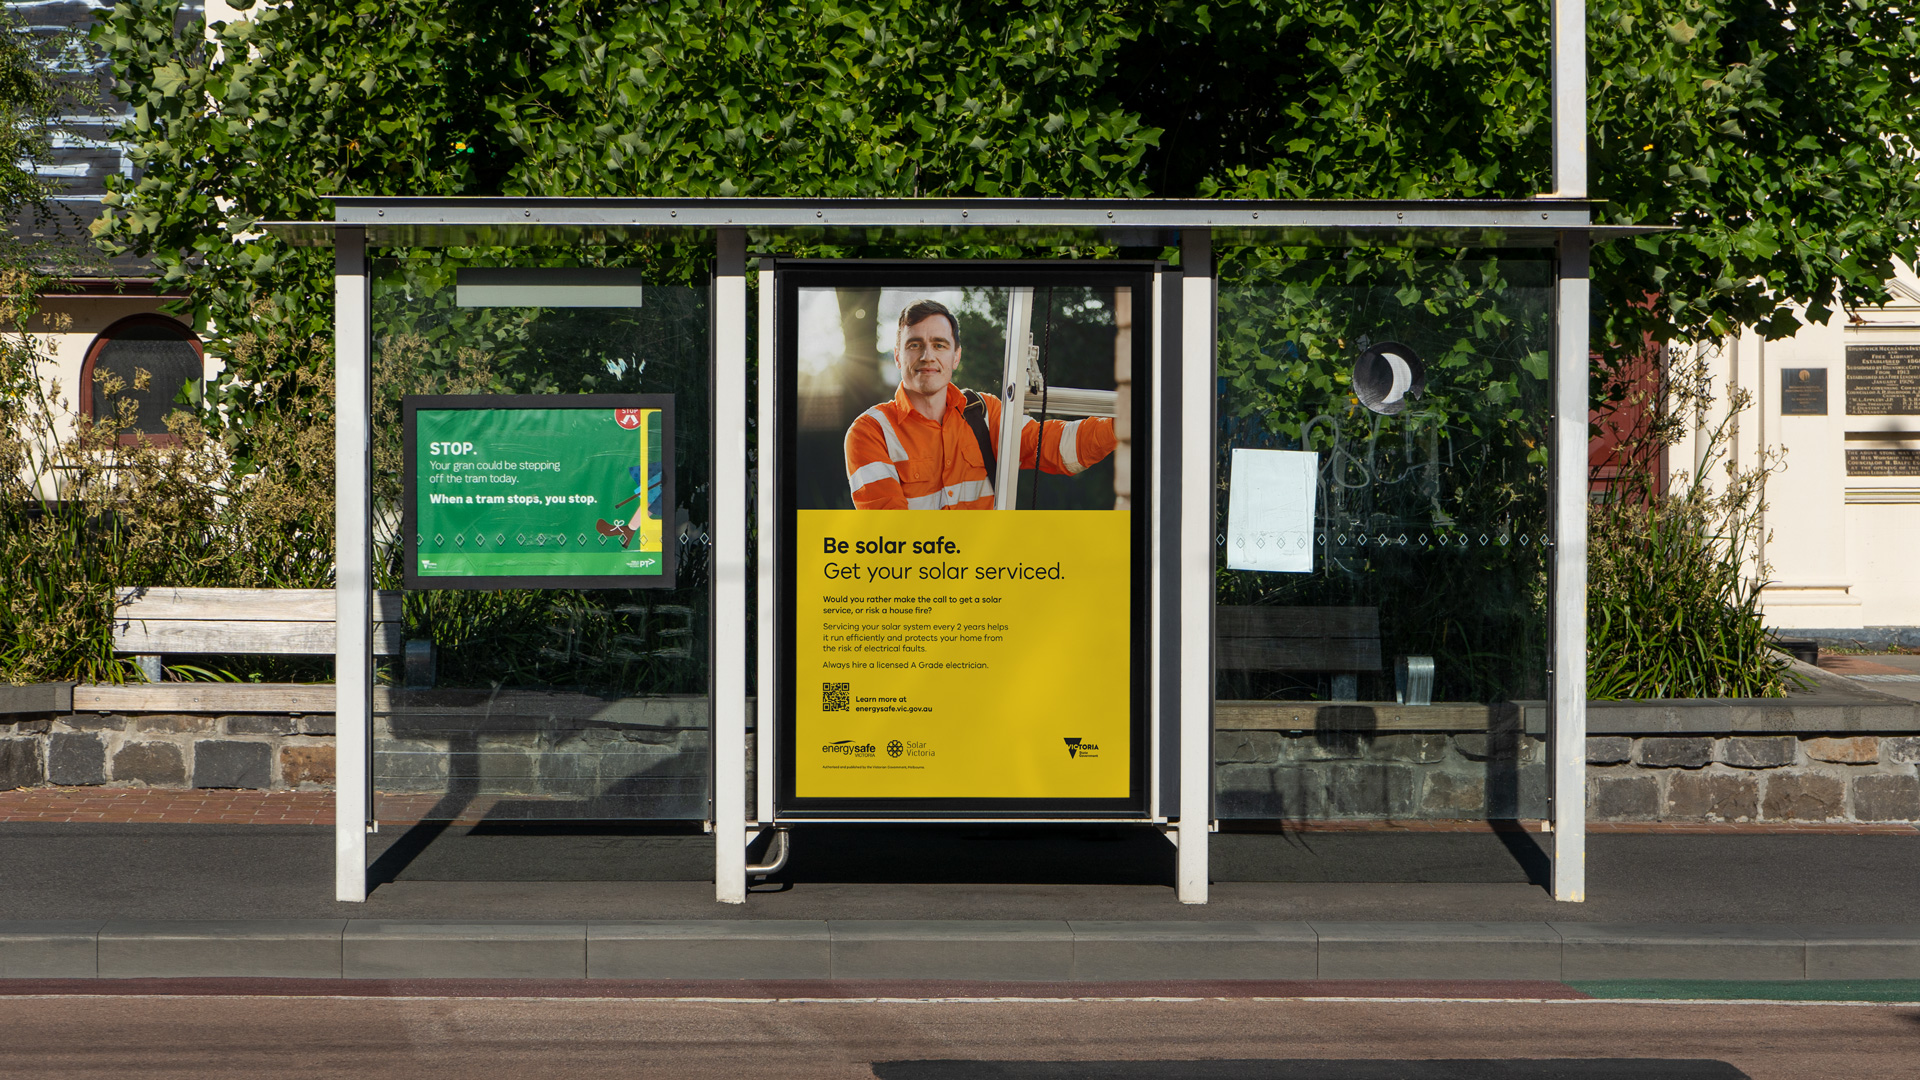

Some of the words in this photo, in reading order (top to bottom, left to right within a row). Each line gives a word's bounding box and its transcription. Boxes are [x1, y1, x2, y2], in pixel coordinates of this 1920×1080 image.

[430, 442, 478, 455] STOP.
[430, 461, 451, 470] Your
[453, 462, 474, 472] gran
[476, 461, 502, 470] could
[504, 460, 517, 470] be
[519, 460, 560, 472] stepping
[429, 473, 444, 483] off
[446, 474, 462, 483] the
[465, 475, 487, 483] tram
[489, 474, 519, 485] today.
[429, 494, 463, 504] When
[475, 495, 505, 503] tram
[507, 494, 542, 506] stops,
[545, 496, 566, 506] you
[568, 494, 597, 505] stop.
[824, 537, 849, 554] Be
[856, 536, 906, 554] solar
[913, 536, 960, 554] safe.
[824, 562, 861, 579] Get
[867, 567, 912, 583] your
[919, 562, 968, 579] solar
[976, 562, 1064, 580] serviced.
[823, 596, 848, 604] Would
[850, 597, 864, 605] you
[867, 596, 892, 604] rather
[894, 596, 915, 604] make
[918, 596, 931, 604] the
[933, 596, 947, 604] call
[959, 597, 972, 605] get
[982, 596, 1002, 604] solar
[823, 607, 853, 615] service,
[866, 607, 879, 615] risk
[890, 607, 913, 615] house
[915, 607, 932, 615] fire?
[823, 623, 859, 633] Servicing
[862, 624, 879, 632] your
[882, 623, 901, 631] solar
[903, 624, 931, 632] system
[957, 623, 961, 631] 2
[987, 623, 1008, 632] helps
[823, 634, 828, 642] it
[846, 634, 885, 643] efficiently
[887, 634, 902, 642] and
[905, 635, 938, 643] protects
[960, 634, 982, 642] home
[984, 634, 1003, 642] from
[823, 645, 836, 653] the
[838, 645, 852, 653] risk
[854, 644, 862, 653] of
[864, 645, 900, 653] electrical
[902, 644, 926, 653] faults.
[823, 661, 850, 670] Always
[852, 661, 867, 669] hire
[877, 661, 908, 669] licensed
[946, 662, 988, 670] electrician.
[856, 705, 932, 713] energysafe.vic.gov.au
[822, 743, 876, 755] energysafe
[906, 741, 927, 749] Solar
[906, 749, 936, 757] Victoria
